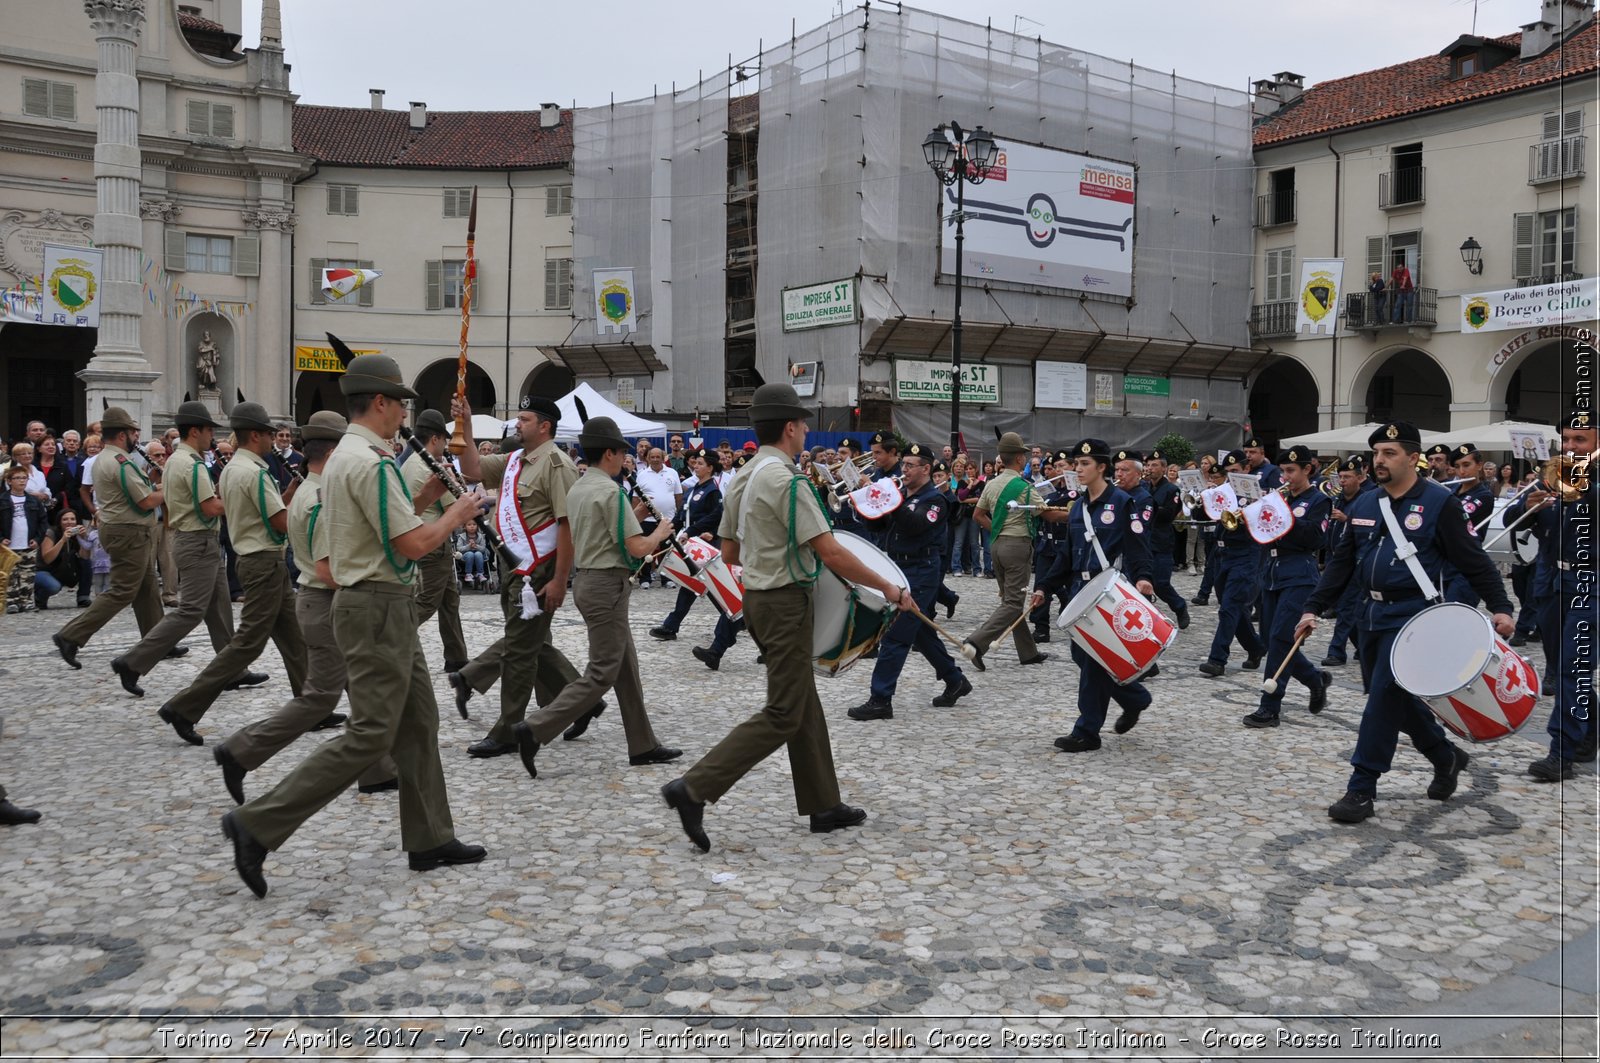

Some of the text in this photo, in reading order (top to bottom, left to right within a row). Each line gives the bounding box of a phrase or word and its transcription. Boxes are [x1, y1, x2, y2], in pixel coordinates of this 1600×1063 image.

[1085, 169, 1132, 190] mensa
[804, 284, 848, 306] IMPRESA ST
[1504, 284, 1580, 302] Palio dei Borghi
[786, 311, 814, 320] EDILIZIA
[815, 304, 852, 317] GENERALE
[1495, 296, 1591, 318] Borgo Gallo
[971, 366, 987, 382] ST
[900, 381, 940, 391] EDILIZIA
[504, 506, 518, 542] CARITAS
